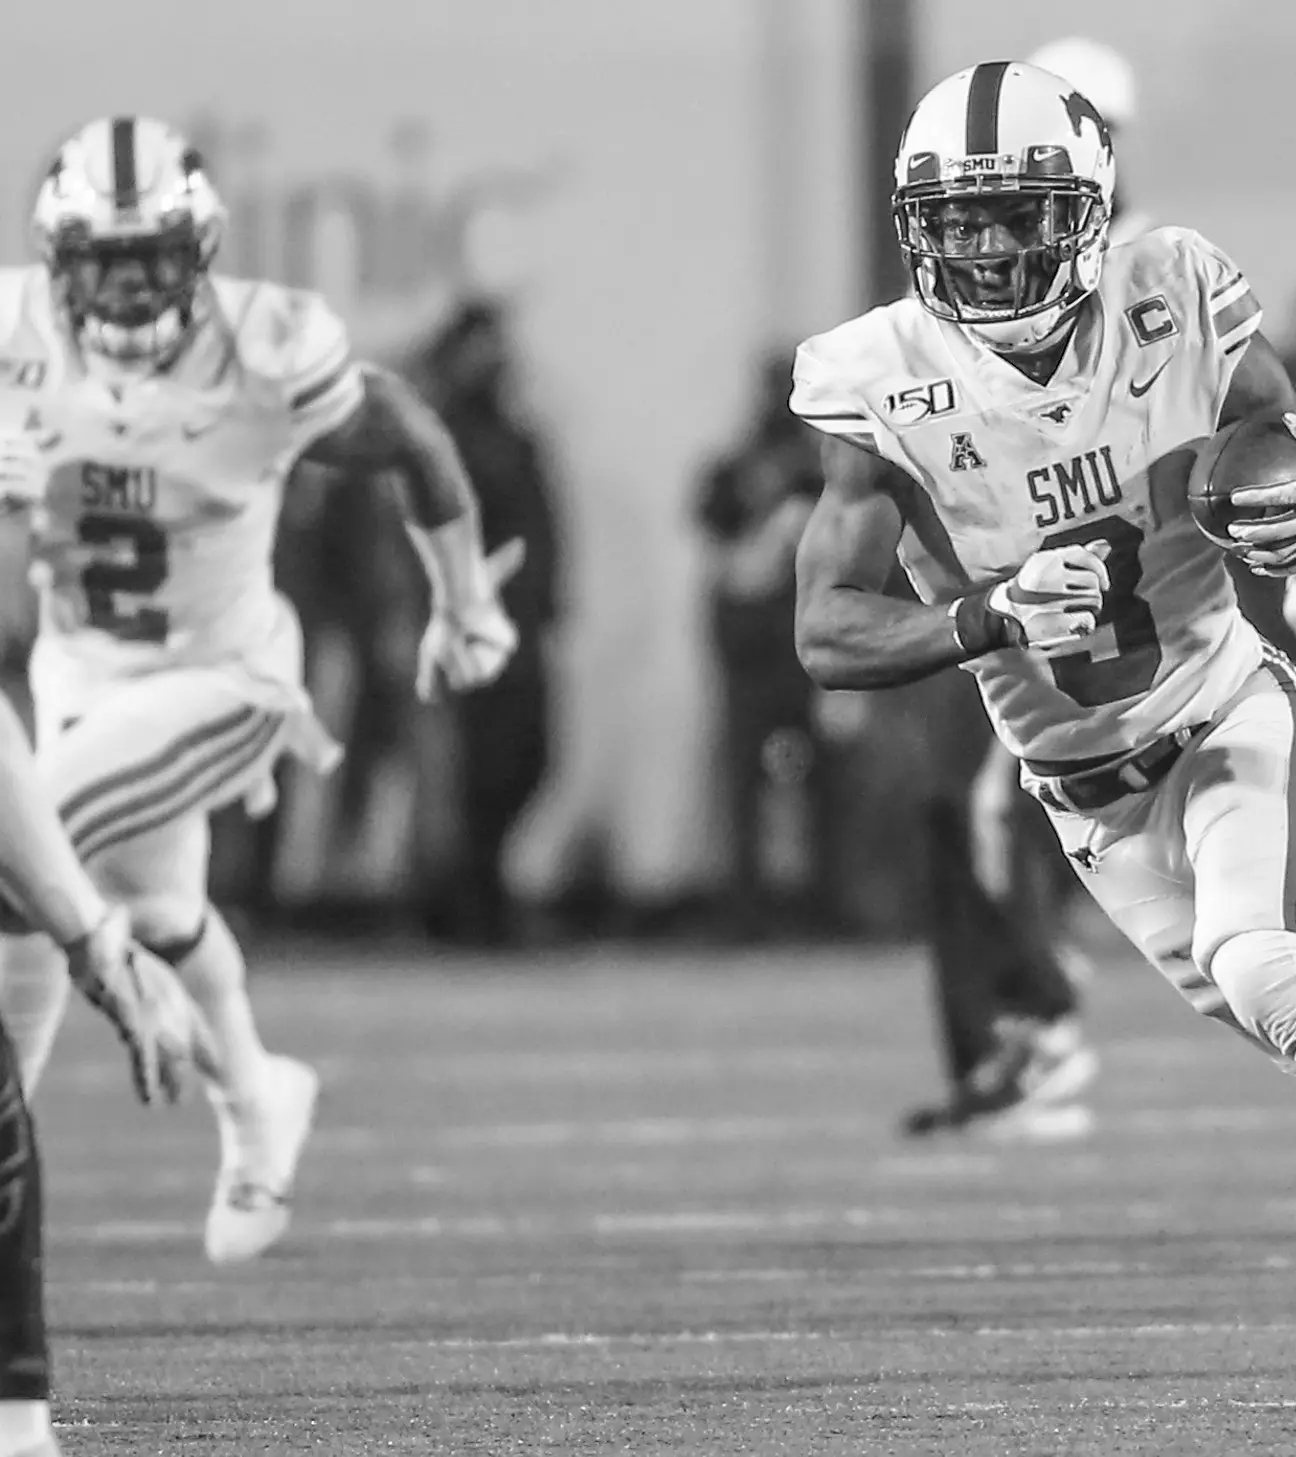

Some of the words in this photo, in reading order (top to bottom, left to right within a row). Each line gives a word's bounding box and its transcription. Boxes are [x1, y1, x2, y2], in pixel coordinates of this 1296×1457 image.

[963, 157, 996, 172] SMU
[1130, 299, 1174, 341] C
[884, 379, 956, 425] 150
[950, 431, 988, 472] A
[81, 460, 156, 512] SMU
[1026, 445, 1123, 529] SMU
[78, 514, 168, 643] 2
